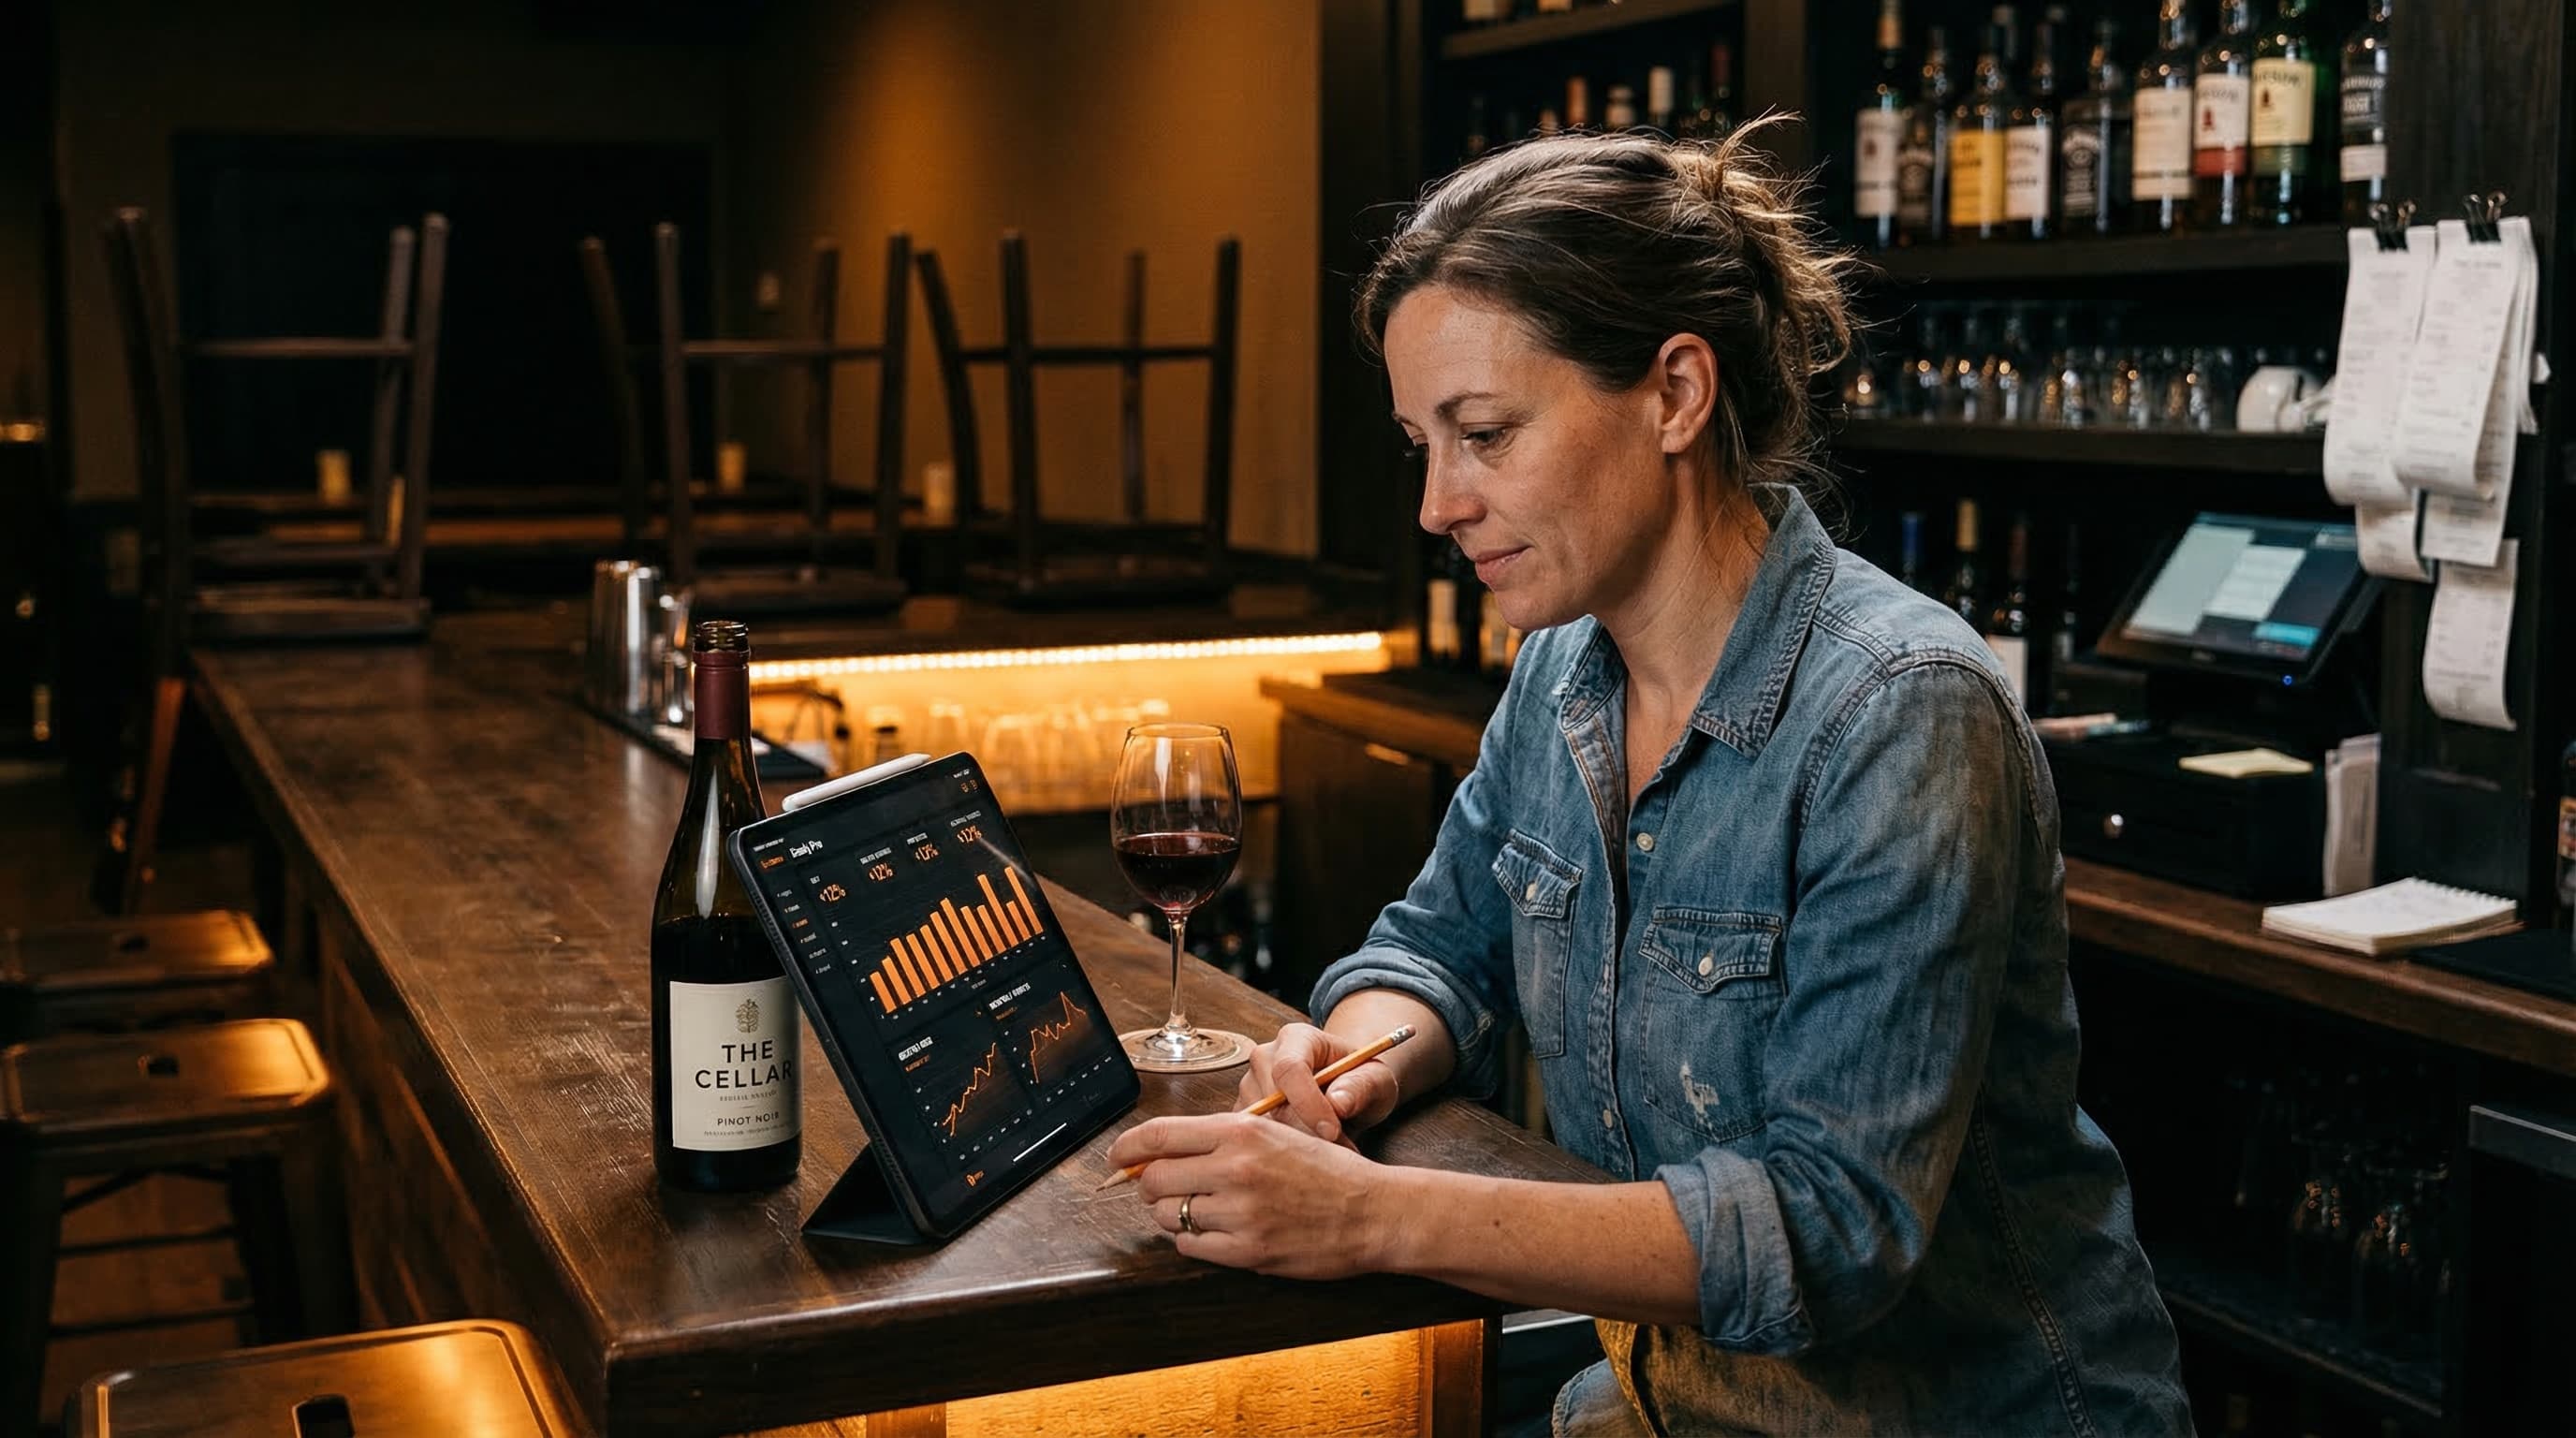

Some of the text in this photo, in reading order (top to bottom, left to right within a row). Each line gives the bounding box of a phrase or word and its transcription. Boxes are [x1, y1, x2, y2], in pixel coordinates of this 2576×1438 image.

[721, 1039, 774, 1064] THE
[695, 1060, 793, 1089] CELLAR
[717, 1116, 752, 1127] PINOT
[755, 1111, 780, 1123] NOIR
